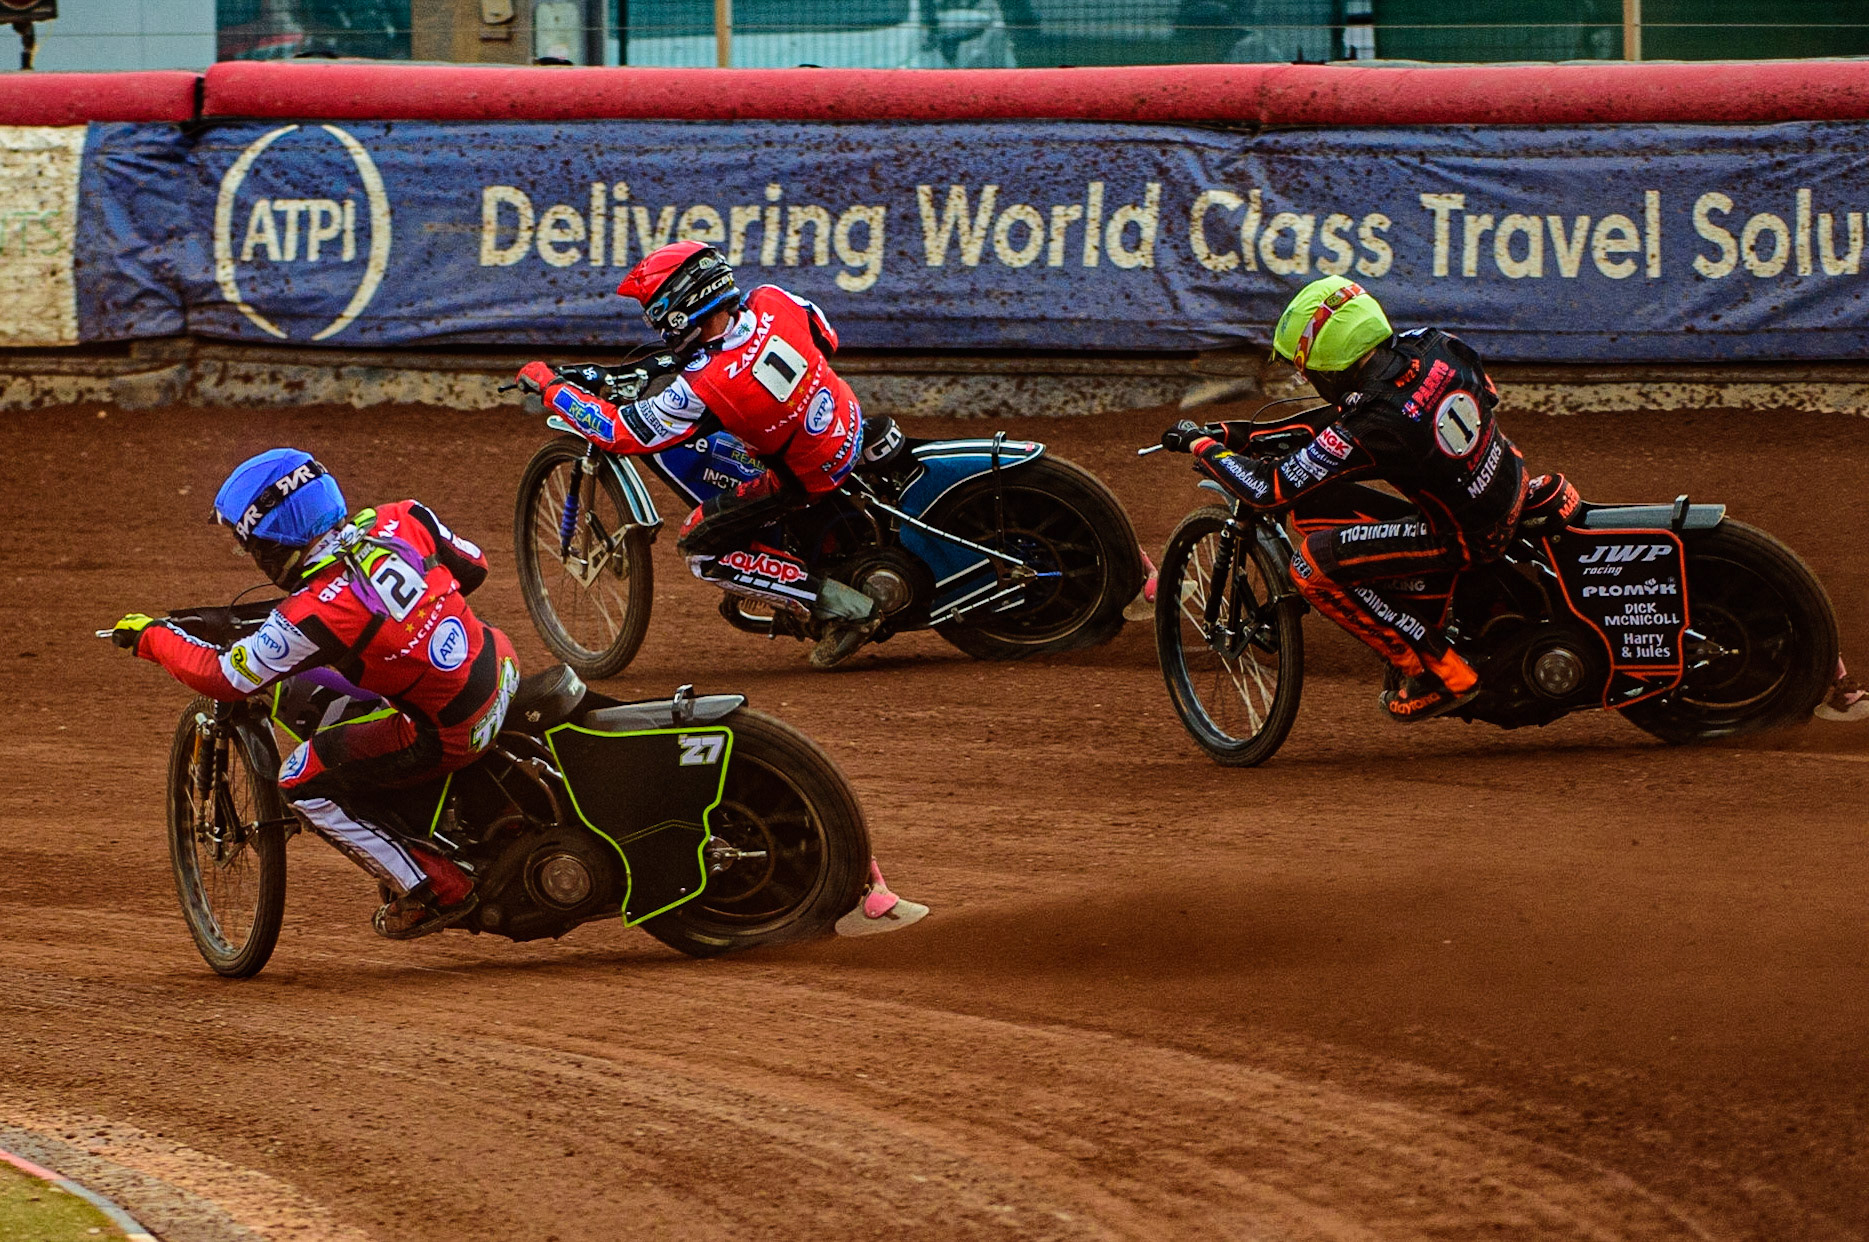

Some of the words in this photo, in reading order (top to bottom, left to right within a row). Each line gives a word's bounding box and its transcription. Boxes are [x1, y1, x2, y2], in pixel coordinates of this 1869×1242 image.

[240, 198, 356, 262] ATPI
[480, 182, 886, 293] Delivering
[918, 182, 1162, 269] World
[1189, 188, 1394, 277] Class
[1419, 188, 1662, 280] Travel
[1692, 187, 1869, 280] Solu
[671, 313, 687, 328] 55
[763, 351, 797, 384] 1
[568, 401, 602, 433] REALL
[813, 397, 828, 427] ATPI
[1447, 406, 1475, 444] 1
[1320, 430, 1350, 455] NGK
[1281, 461, 1304, 488] SKIPS
[1467, 440, 1502, 499] MASTERS
[1339, 523, 1401, 544] MCNICOLL
[1578, 544, 1673, 564] JWP
[1583, 564, 1623, 576] racing
[376, 567, 418, 610] 2
[1604, 612, 1680, 626] MCNICOLL
[1625, 602, 1657, 614] DICK
[1397, 612, 1426, 641] DICK
[1624, 632, 1664, 648] Harry
[260, 632, 282, 653] ATPI
[439, 627, 460, 662] ATPI
[1621, 648, 1632, 658] &
[1636, 645, 1671, 658] Jules
[1389, 691, 1441, 715] daytona
[680, 735, 724, 765] 27
